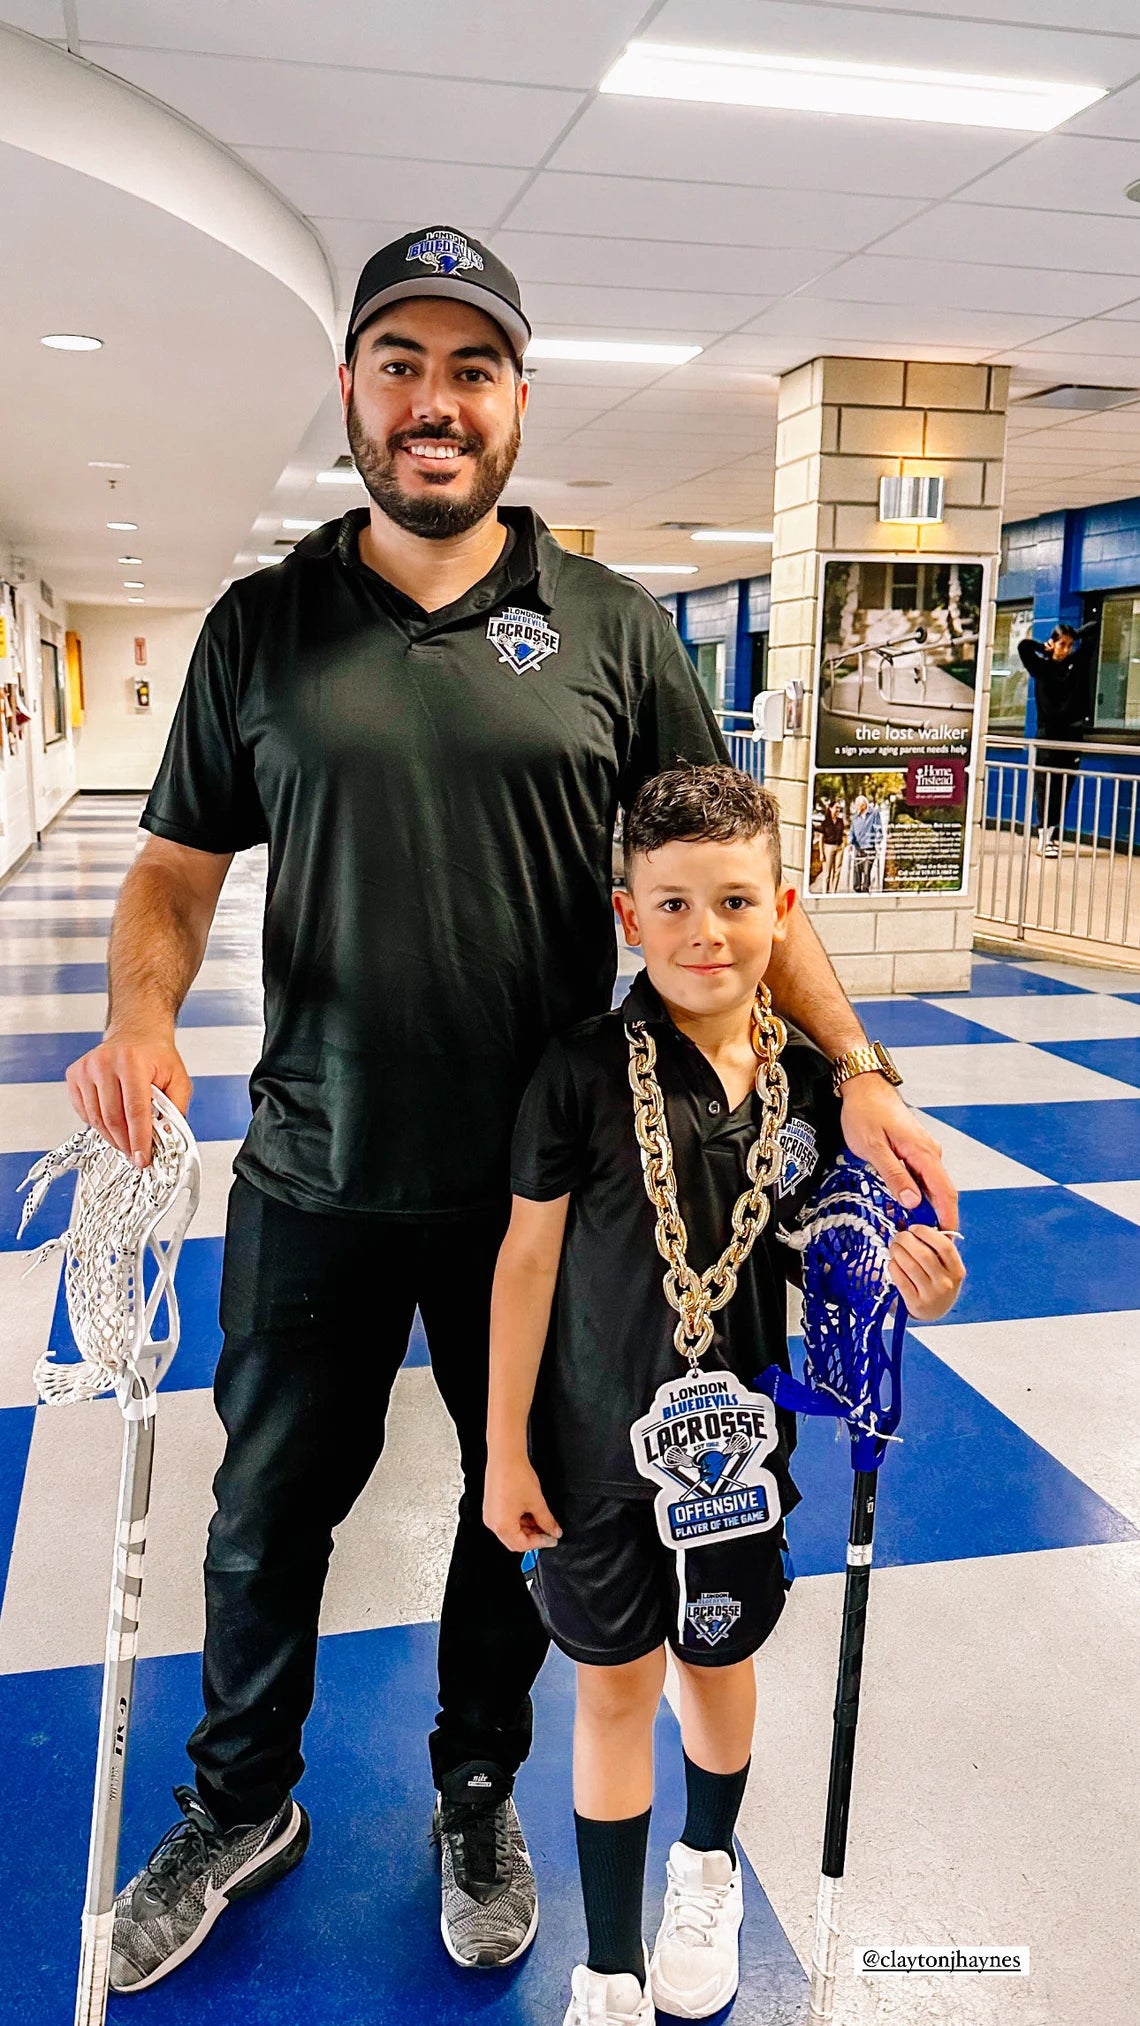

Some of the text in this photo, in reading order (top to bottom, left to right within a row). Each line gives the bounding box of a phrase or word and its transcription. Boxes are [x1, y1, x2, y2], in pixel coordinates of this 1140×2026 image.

[427, 232, 466, 247] LONDON
[503, 613, 546, 629] BLUEDEVILS
[509, 608, 542, 620] LONDON
[489, 622, 558, 650] LACROSSE
[855, 724, 969, 740] the lost walker
[841, 745, 857, 756] sign
[858, 746, 877, 756] your
[878, 745, 898, 756] aging
[899, 745, 925, 756] parent
[926, 744, 949, 754] needs
[950, 744, 968, 755] help
[924, 765, 952, 777] Home
[916, 774, 954, 786] Instead
[793, 1119, 816, 1137] LONDON
[779, 1136, 817, 1173] ACROSSE
[669, 1382, 729, 1403] LONDON
[662, 1394, 739, 1421] BLUEDEVILS
[643, 1411, 768, 1464] LACROSSE
[674, 1491, 759, 1523] OFFENSIVE
[675, 1510, 765, 1538] PLAYER OF THE GAME
[687, 1605, 740, 1618] LACROSSE
